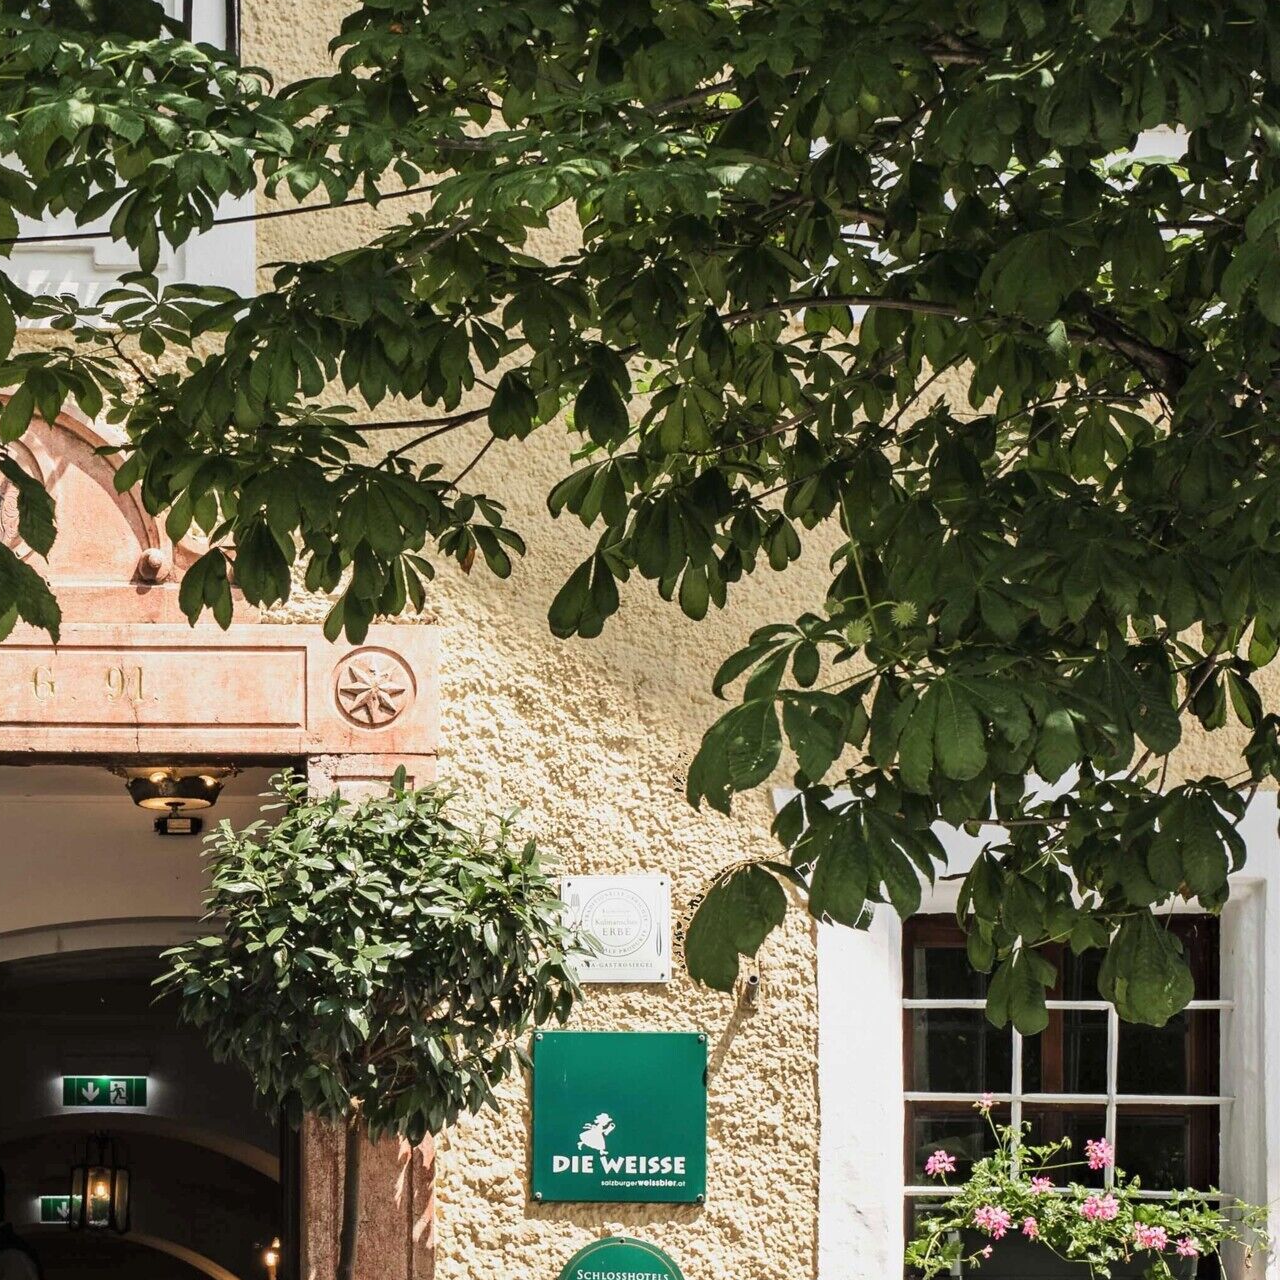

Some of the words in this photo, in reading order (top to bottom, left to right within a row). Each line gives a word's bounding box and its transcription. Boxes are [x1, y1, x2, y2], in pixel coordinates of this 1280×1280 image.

[602, 928, 631, 936] ERBE
[552, 1155, 594, 1173] DIE
[600, 1155, 686, 1174] WEISSE
[601, 1179, 686, 1187] salzburgerweissbier.at
